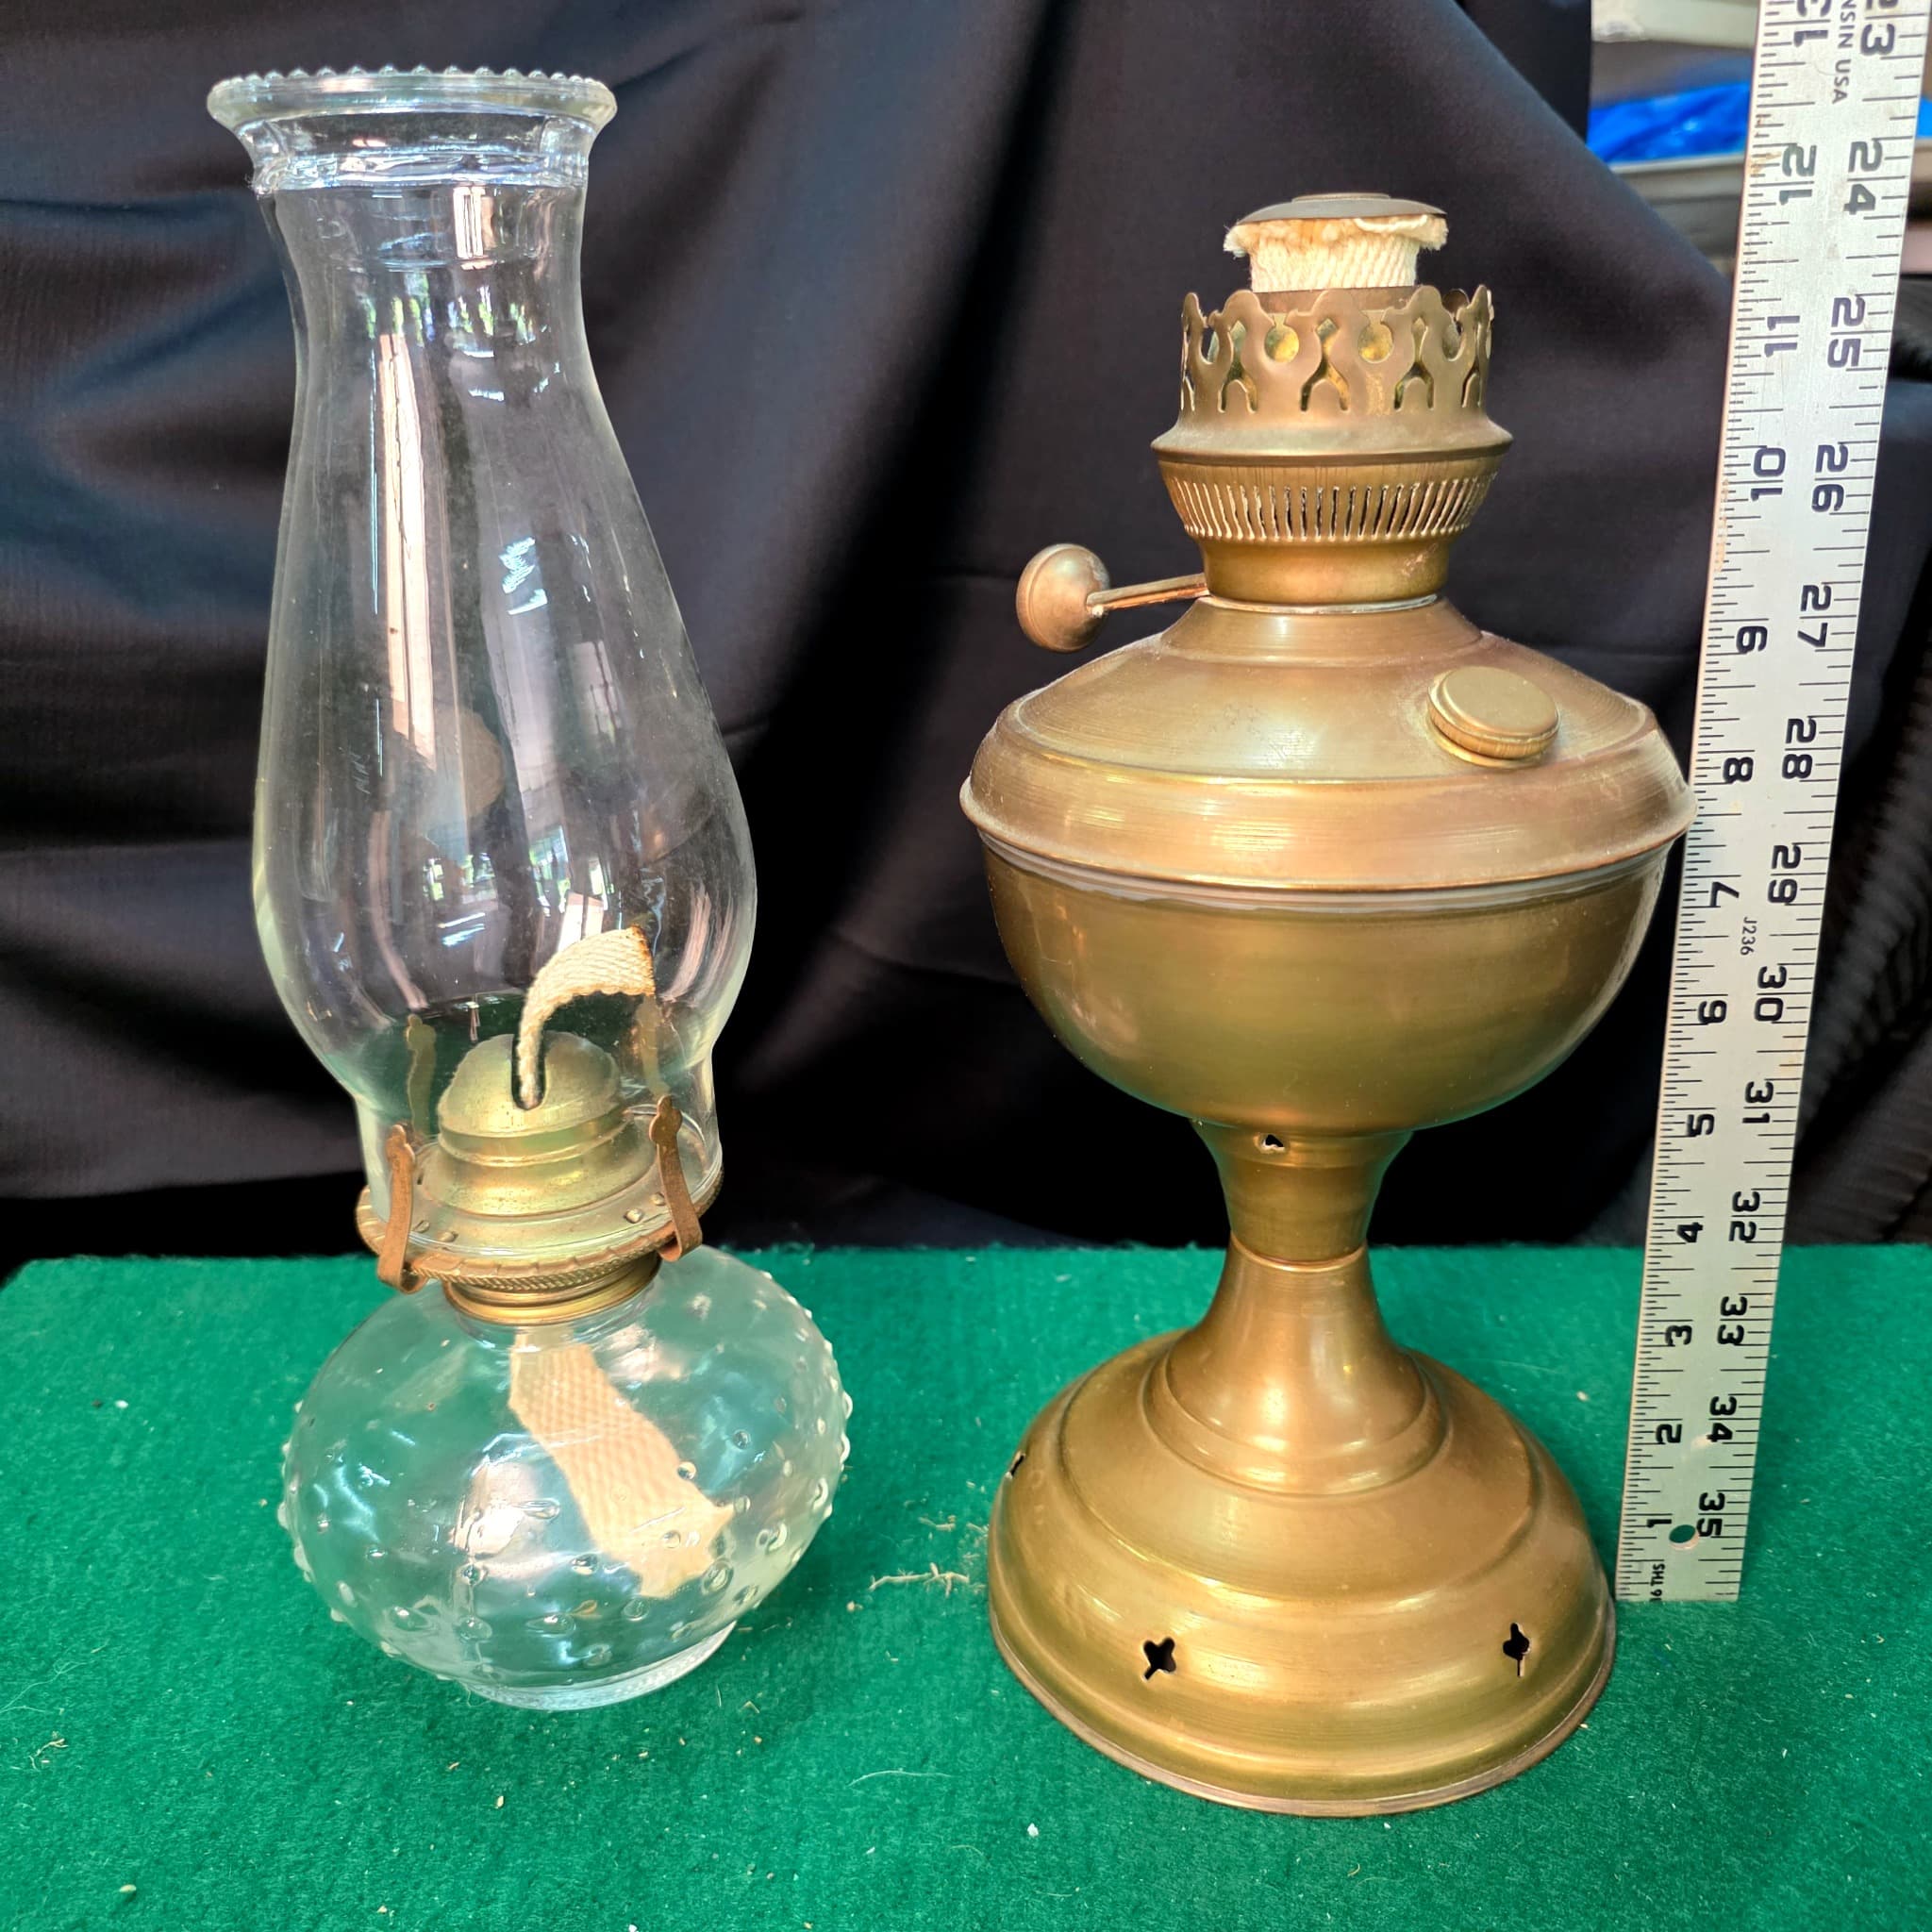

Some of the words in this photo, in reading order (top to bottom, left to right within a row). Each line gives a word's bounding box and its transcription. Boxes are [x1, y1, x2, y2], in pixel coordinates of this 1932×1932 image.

[1832, 58, 1851, 105] USA
[1778, 143, 1818, 205] 12
[1843, 141, 1883, 215] 24
[1764, 315, 1800, 358] 11
[1827, 297, 1866, 368] 25
[1751, 447, 1787, 501] 10
[1811, 444, 1849, 512] 26
[1797, 584, 1832, 647] 27
[1736, 625, 1768, 653] 9
[1723, 757, 1754, 783] 8
[1782, 718, 1817, 779] 28
[1709, 881, 1740, 908] 7
[1767, 844, 1801, 905] 29
[1740, 916, 1757, 956] J236
[1698, 999, 1727, 1024] 6
[1754, 966, 1788, 1023] 30
[1687, 1113, 1715, 1138] 5
[1742, 1081, 1774, 1124] 31
[1676, 1222, 1704, 1243] 4
[1728, 1191, 1760, 1242] 32
[1664, 1324, 1692, 1347] 3
[1717, 1296, 1747, 1346] 33
[1656, 1424, 1682, 1445] 2
[1707, 1396, 1737, 1442] 34
[1647, 1518, 1673, 1528] 1
[1697, 1492, 1725, 1538] 35
[1651, 1563, 1665, 1586] THS
